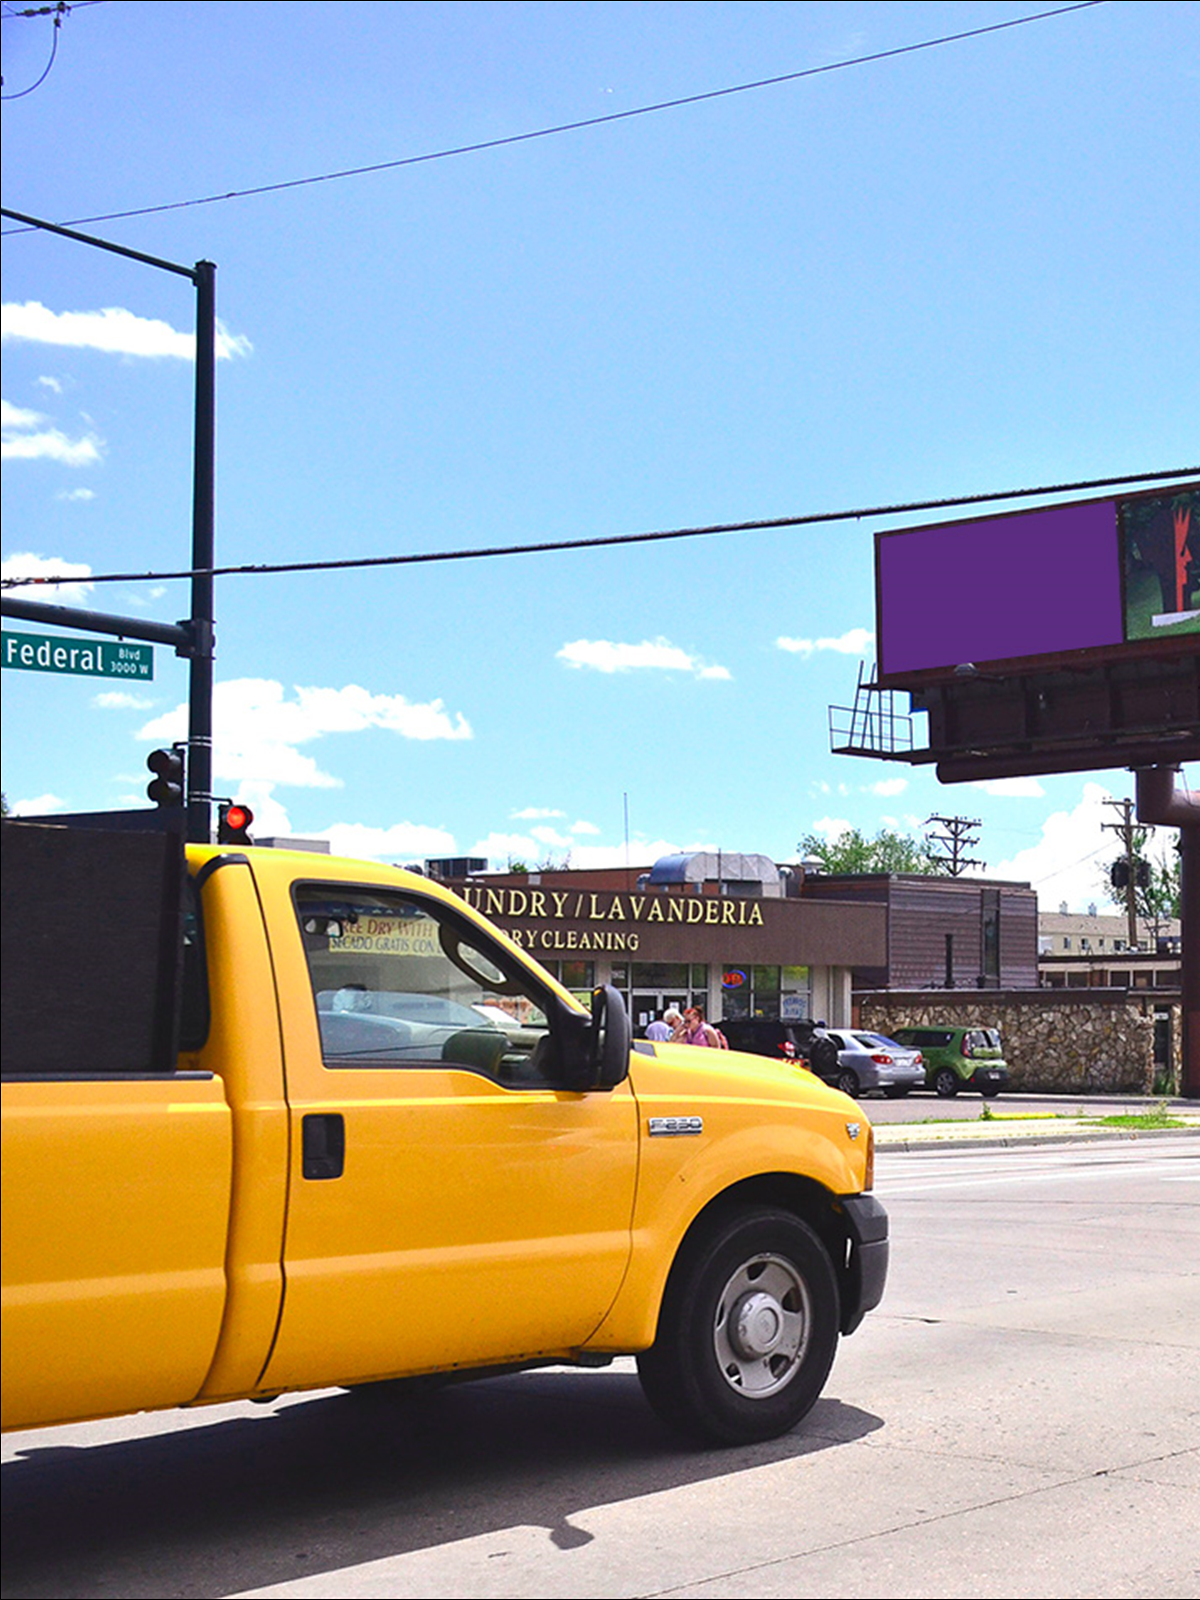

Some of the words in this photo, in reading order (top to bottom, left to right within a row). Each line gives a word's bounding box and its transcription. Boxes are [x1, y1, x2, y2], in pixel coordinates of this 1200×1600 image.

[6, 638, 104, 672] Federal
[118, 648, 140, 661] Blvd
[110, 661, 136, 674] 3000
[139, 664, 148, 675] W
[449, 887, 568, 918] UNDRY
[589, 893, 764, 926] LAVANDERIA
[541, 931, 639, 951] CLEANING
